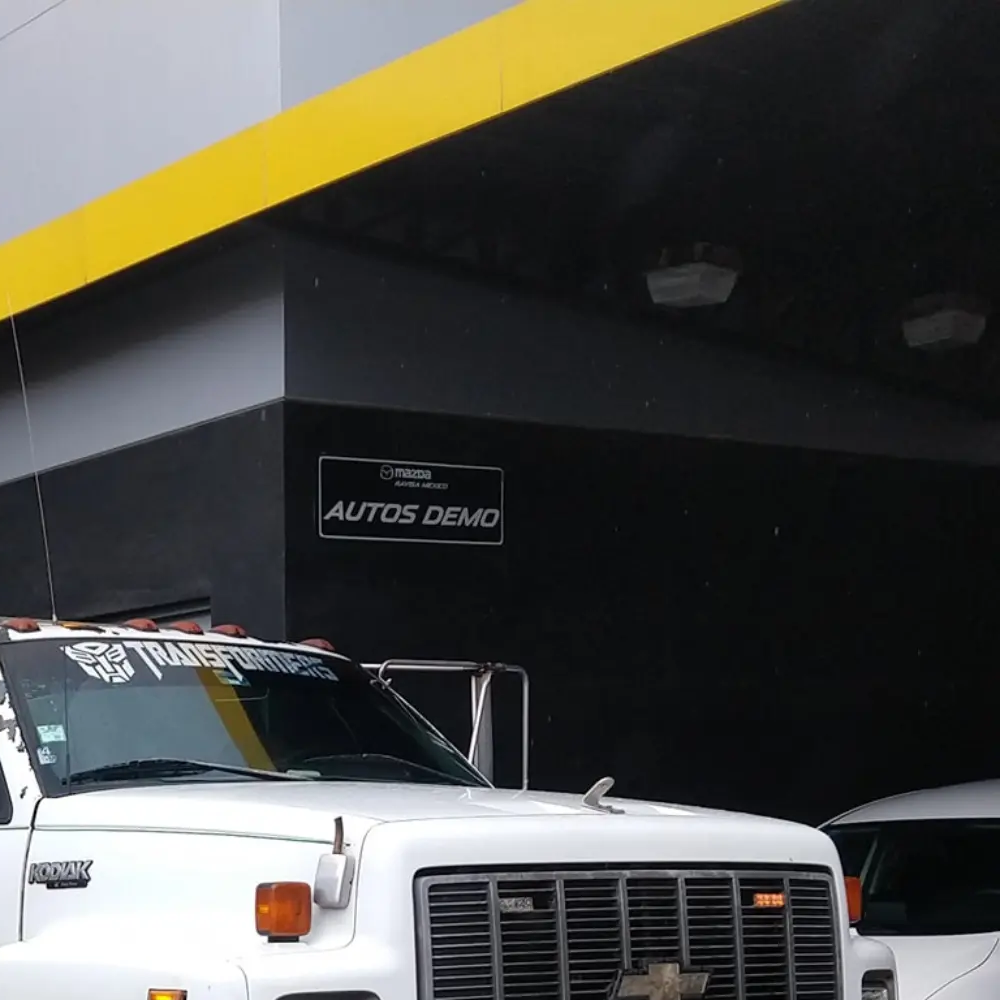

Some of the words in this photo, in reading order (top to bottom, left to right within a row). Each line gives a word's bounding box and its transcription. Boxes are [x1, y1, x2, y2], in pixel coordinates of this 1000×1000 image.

[395, 467, 432, 480] mazda
[323, 500, 419, 524] AUTOS
[422, 505, 500, 528] DEMO
[125, 640, 340, 682] TRANSFORMERS
[28, 860, 94, 884] KODIAK
